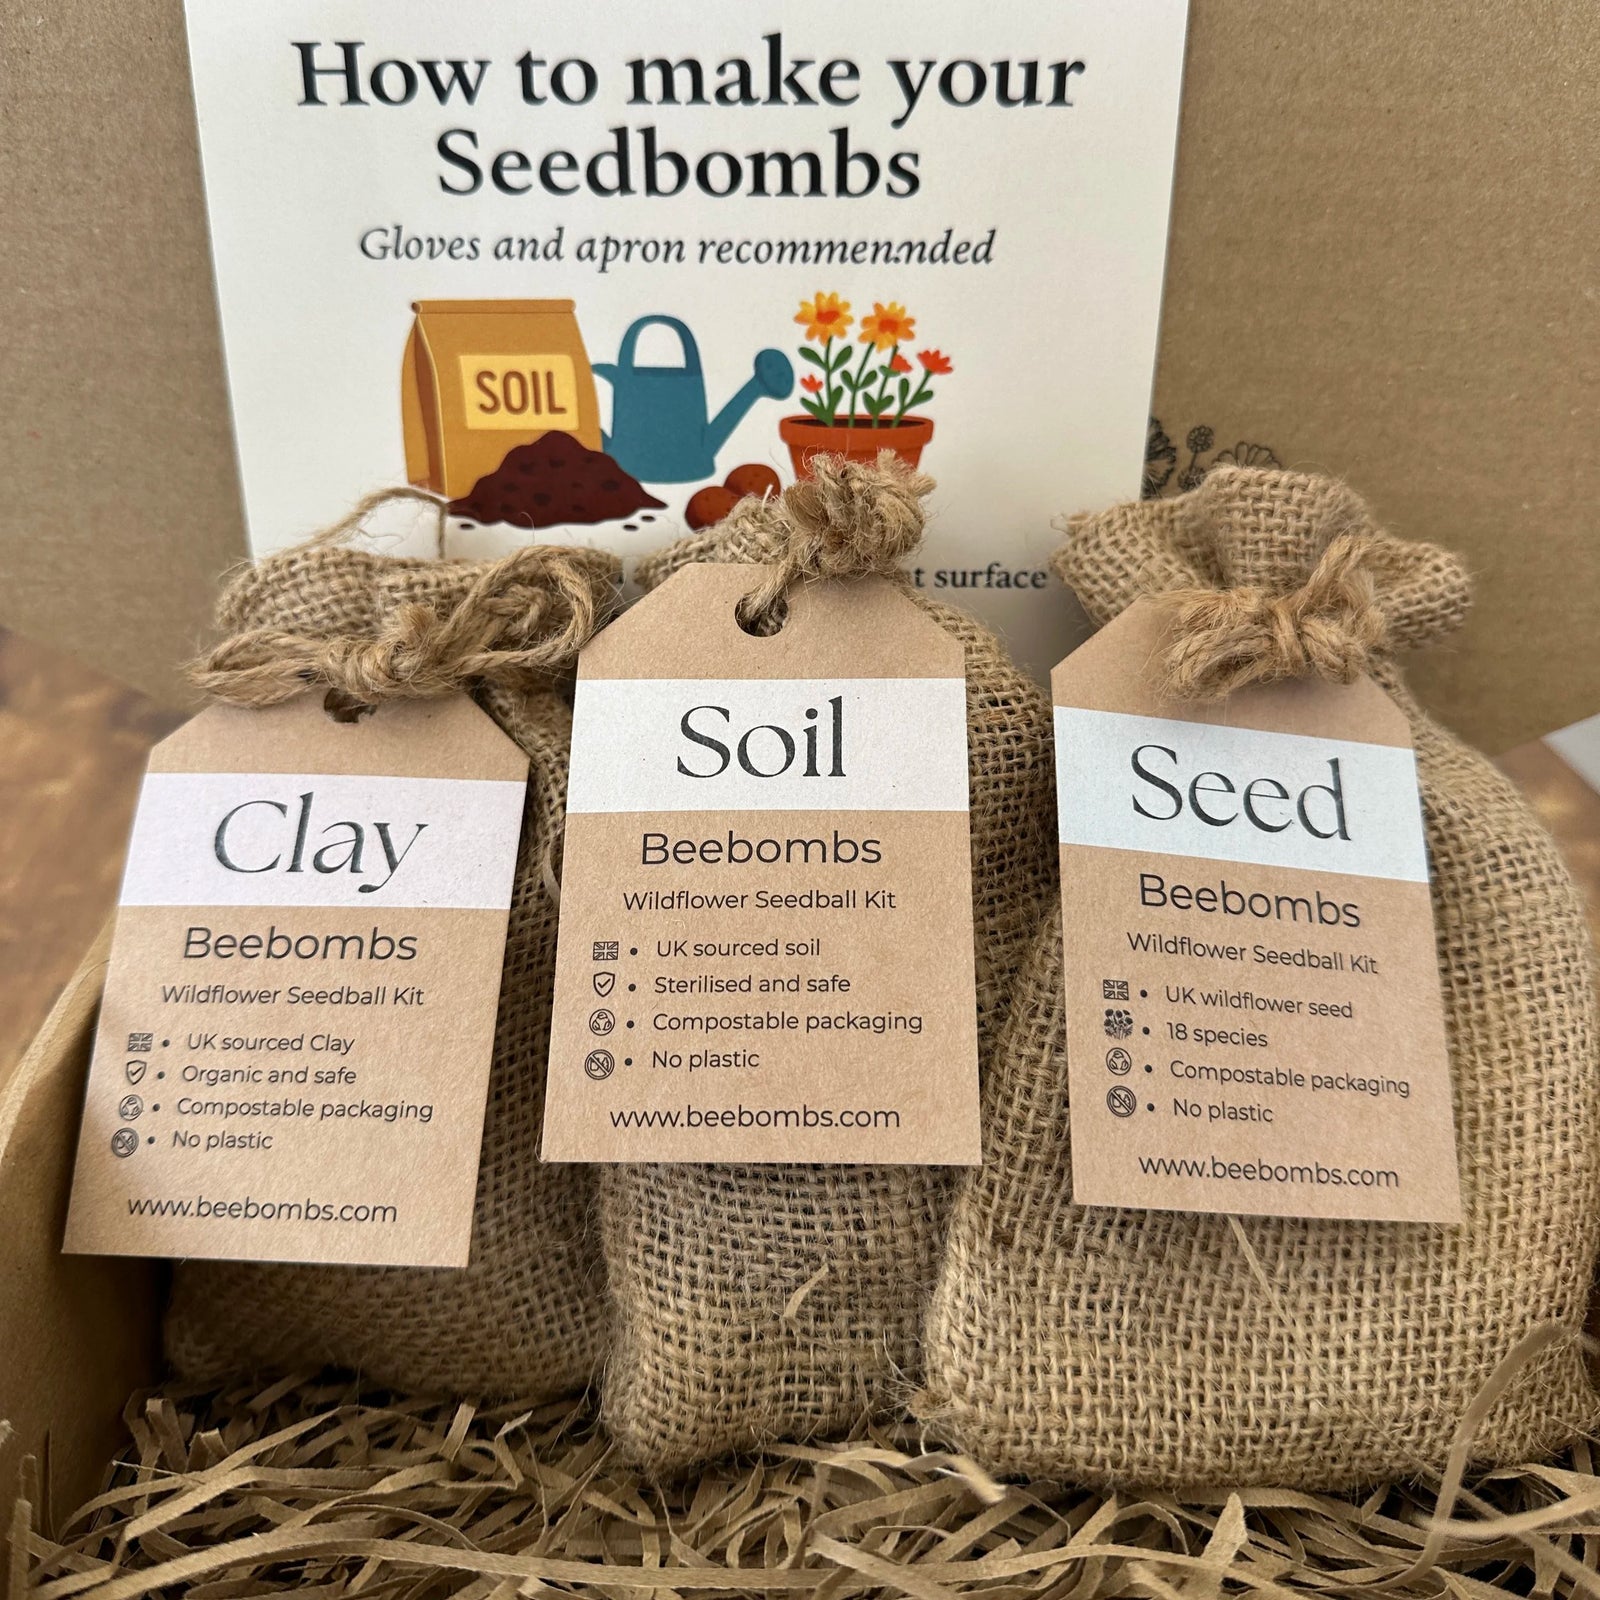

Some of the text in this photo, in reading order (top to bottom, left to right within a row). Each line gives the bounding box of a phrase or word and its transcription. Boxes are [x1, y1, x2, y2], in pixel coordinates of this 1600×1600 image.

[292, 33, 1086, 128] How to make your
[436, 127, 920, 198] Seedbombs
[359, 225, 480, 262] Gloves
[494, 227, 564, 262] and
[577, 233, 686, 272] apron
[476, 369, 567, 417] SOIL
[934, 561, 1047, 589] surface
[676, 695, 846, 778] Soil
[1130, 744, 1352, 842] Seed
[214, 792, 429, 893] Clay
[641, 831, 882, 865] Beebombs
[623, 890, 896, 911] Wildflower Seedball Kit
[1139, 872, 1361, 928] Beebombs
[183, 926, 418, 961] Beebombs
[657, 939, 821, 957] UK sourced soil
[1126, 931, 1379, 974] Wildflower Seedball Kit
[162, 984, 425, 1006] Wildflower Seedball Kit
[654, 975, 851, 994] Sterilised and safe
[1165, 986, 1353, 1019] UK wildflower seed
[652, 1012, 923, 1035] Compostable packaging
[1167, 1023, 1268, 1049] 18 species
[187, 1033, 355, 1055] UK sourced Clay
[652, 1050, 760, 1072] No plastic
[181, 1065, 357, 1088] Organic and safe
[1170, 1060, 1410, 1098] Compostable packaging
[176, 1098, 434, 1122] Compostable packaging
[610, 1106, 900, 1129] www.beebombs.com
[1173, 1099, 1273, 1124] No plastic
[172, 1130, 273, 1153] No plastic
[1138, 1154, 1400, 1188] www.beebombs.com
[127, 1197, 398, 1223] www.beebombs.com
